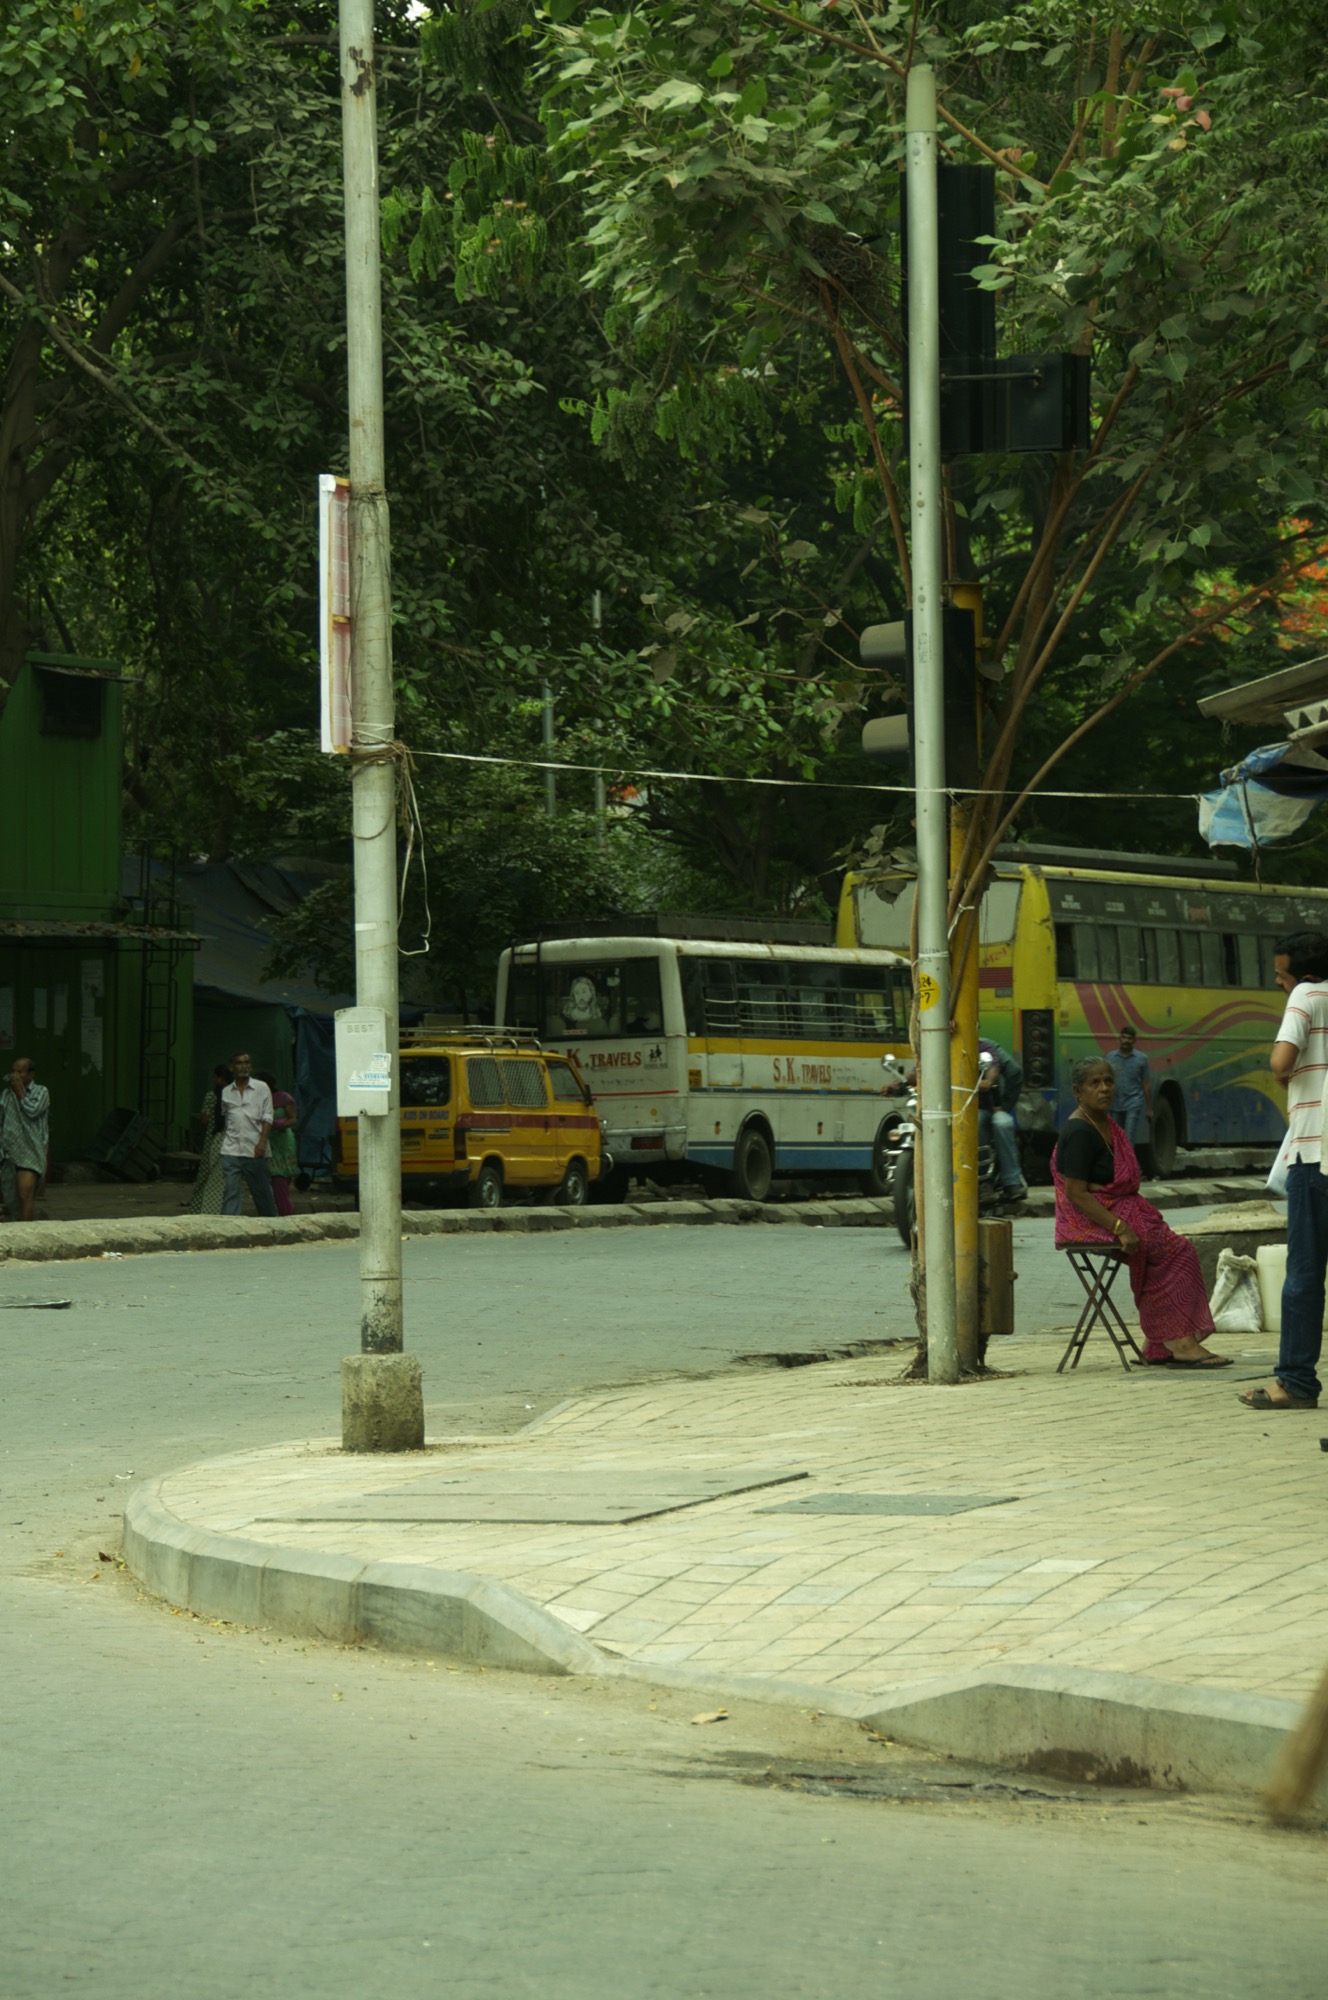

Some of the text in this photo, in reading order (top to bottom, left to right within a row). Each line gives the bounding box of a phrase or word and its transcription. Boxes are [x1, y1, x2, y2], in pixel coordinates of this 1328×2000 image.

[347, 1024, 374, 1033] BEST
[590, 1051, 642, 1068] TRAVELS
[802, 1063, 832, 1084] TRAVELS
